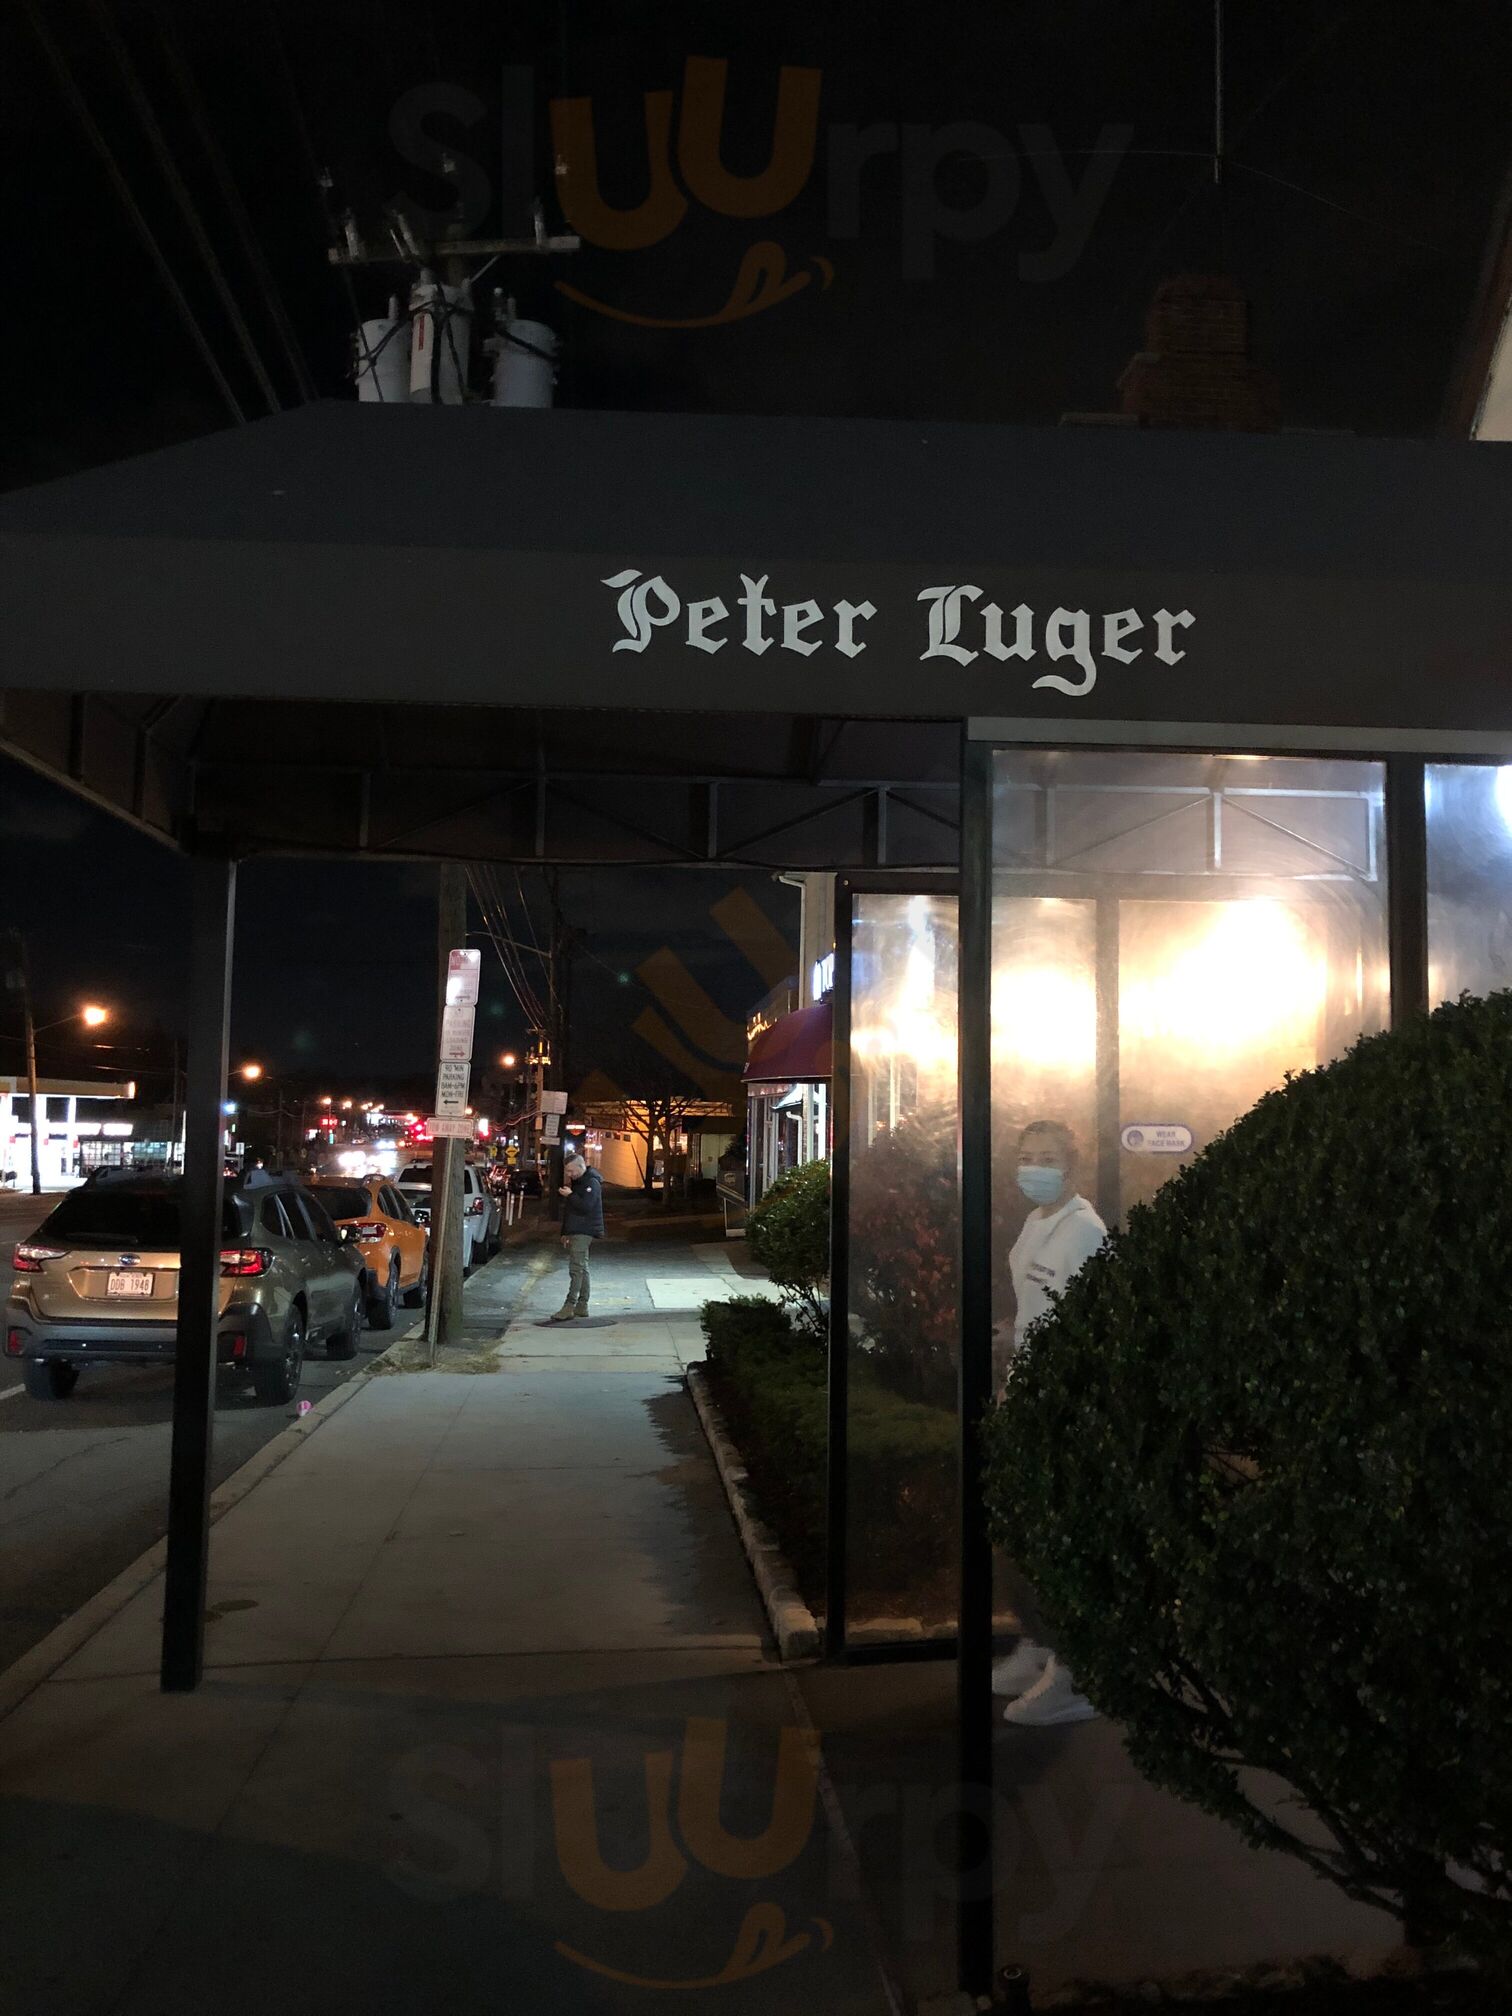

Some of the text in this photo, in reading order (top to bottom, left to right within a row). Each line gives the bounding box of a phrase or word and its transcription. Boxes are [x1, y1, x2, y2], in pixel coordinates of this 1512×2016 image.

[600, 568, 1197, 697] Peter Luger
[442, 1073, 465, 1081] PARKING
